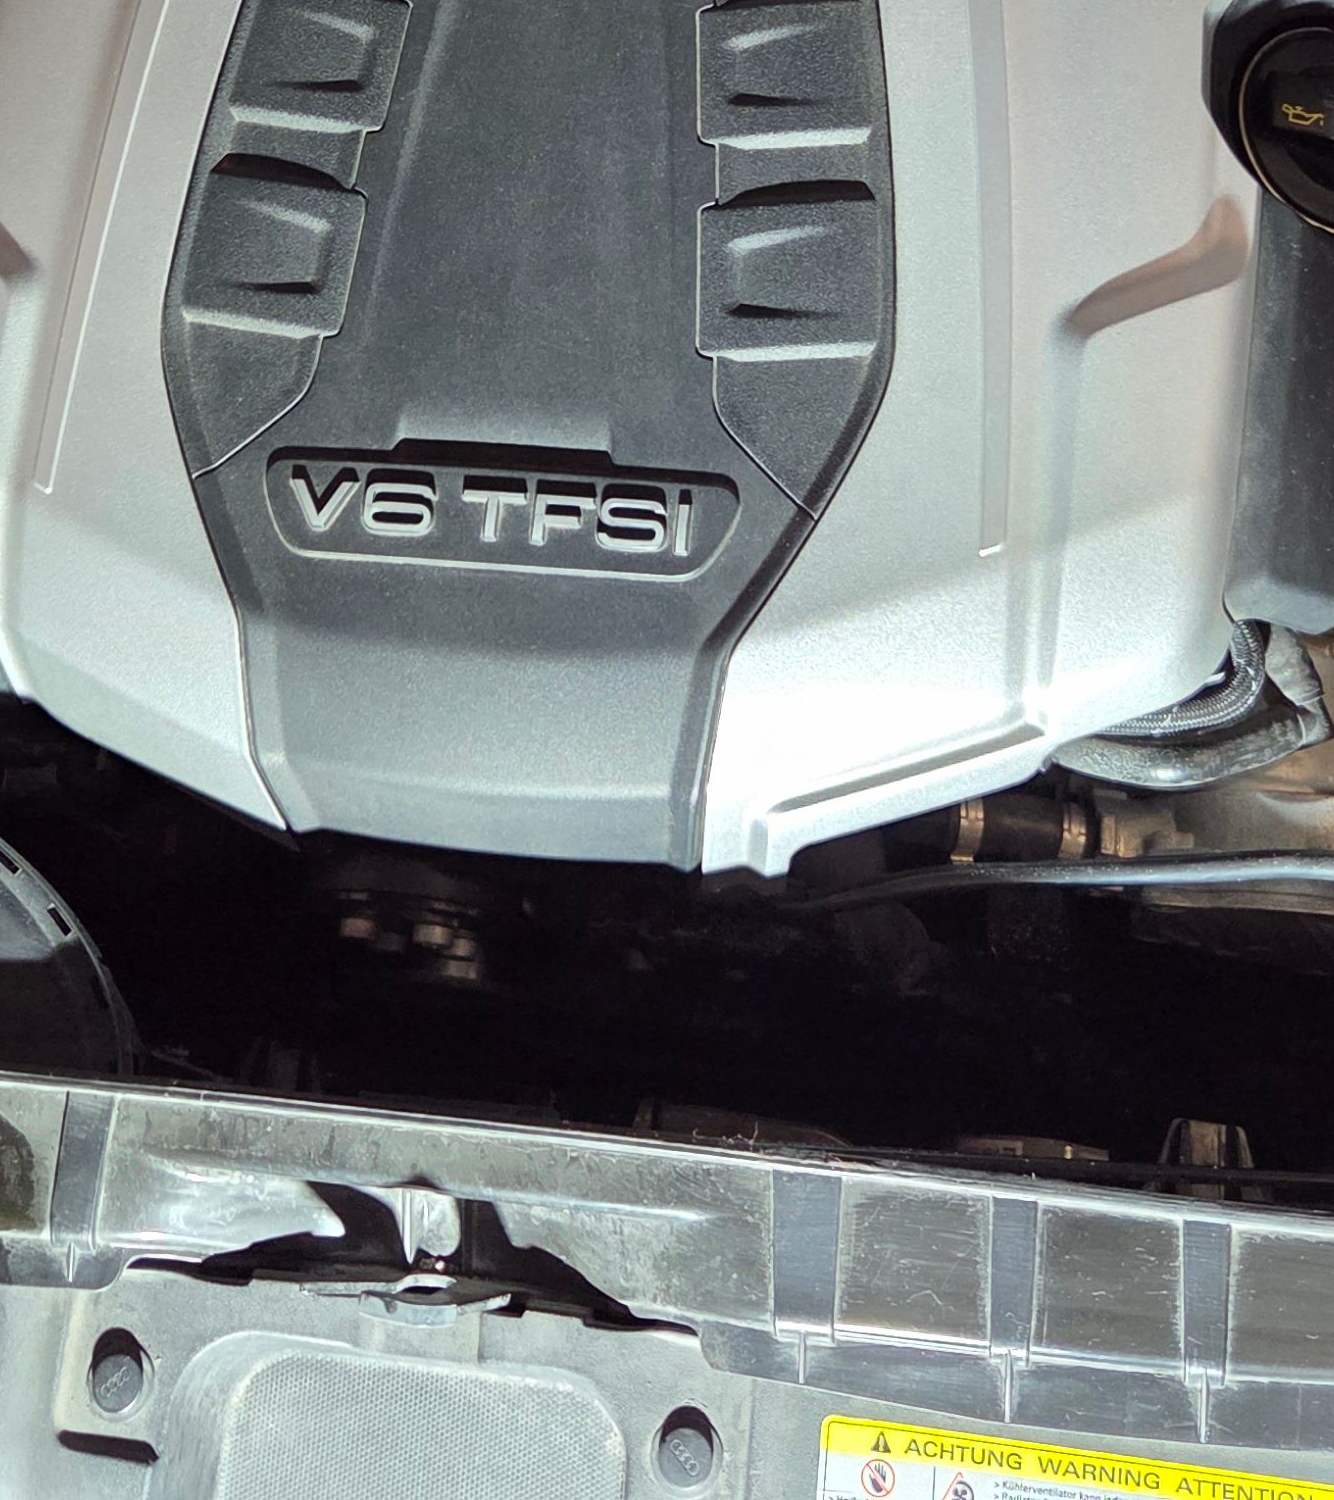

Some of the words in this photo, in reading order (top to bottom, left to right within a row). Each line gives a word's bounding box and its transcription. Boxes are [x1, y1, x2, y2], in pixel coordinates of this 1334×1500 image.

[289, 464, 437, 537] V6
[904, 1438, 1023, 1471] ACHTUNG
[1037, 1456, 1161, 1490] WARNING
[1001, 1480, 1077, 1499] Kühlerventilator
